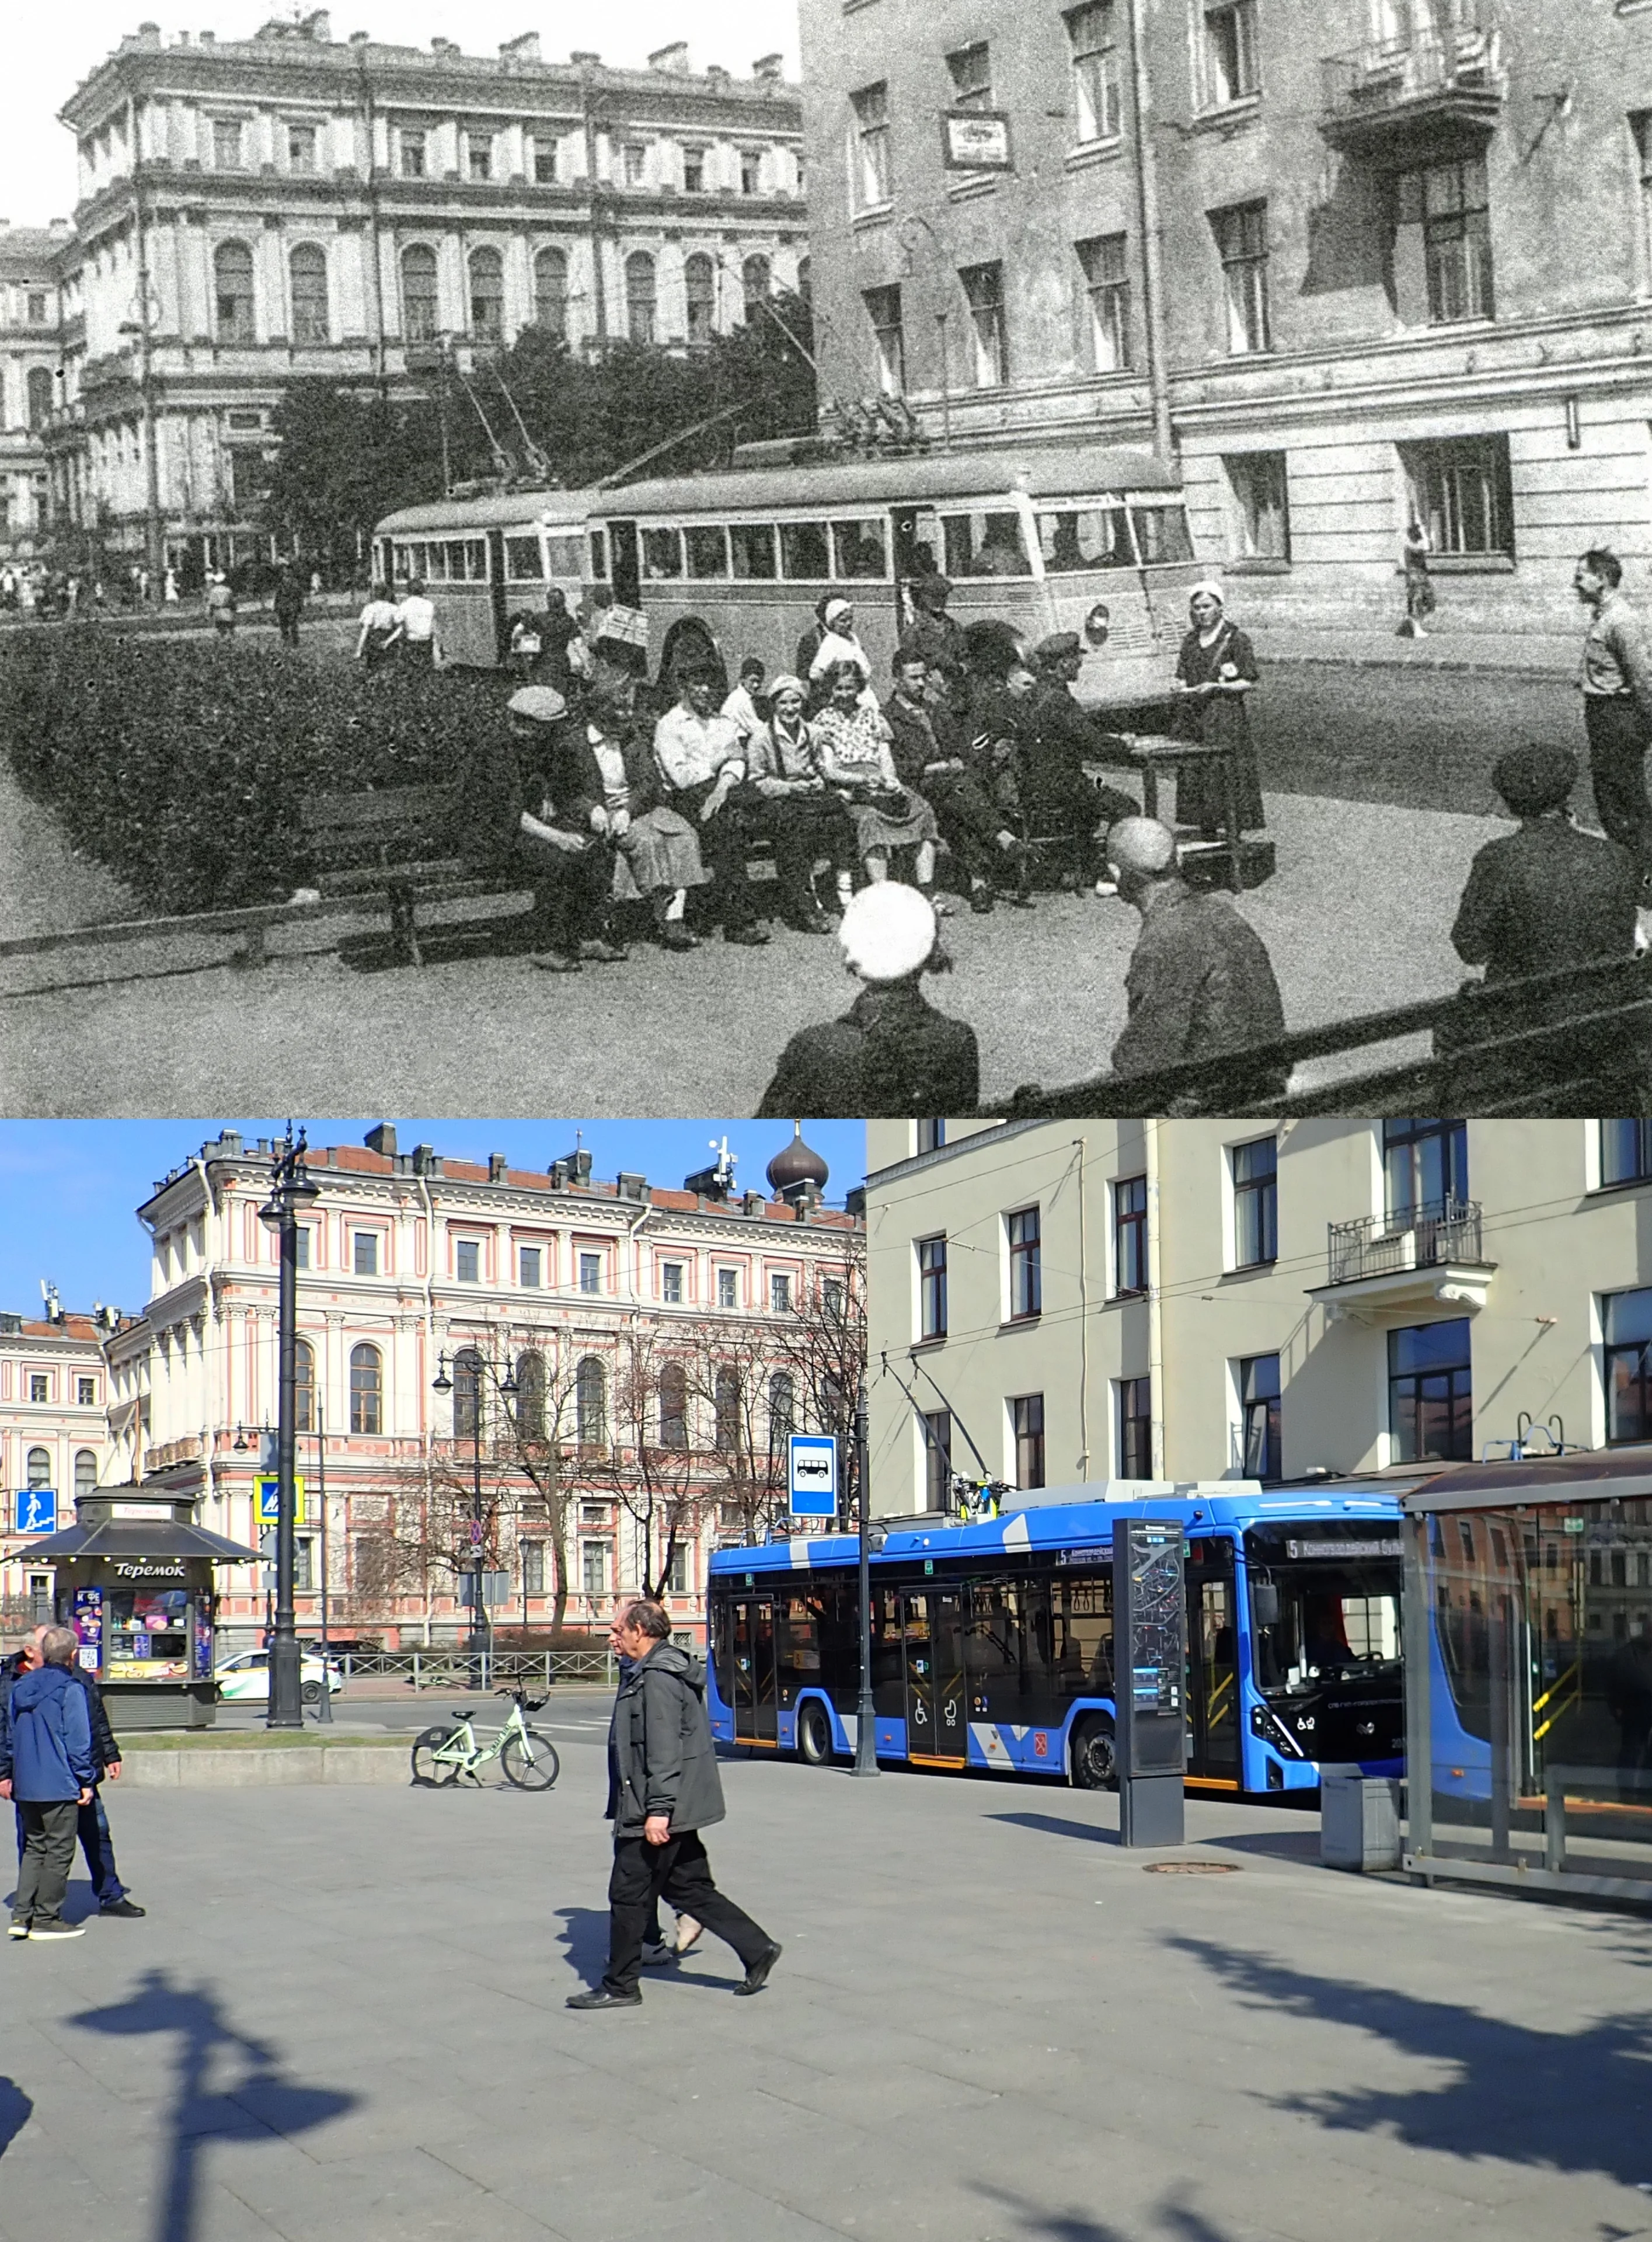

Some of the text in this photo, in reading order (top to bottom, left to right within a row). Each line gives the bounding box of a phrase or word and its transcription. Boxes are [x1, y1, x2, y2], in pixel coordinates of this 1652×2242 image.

[1289, 1540, 1298, 1558] 5
[1061, 1550, 1067, 1565] 5
[114, 1562, 185, 1579] Теремок
[77, 1592, 100, 1602] КФЕ
